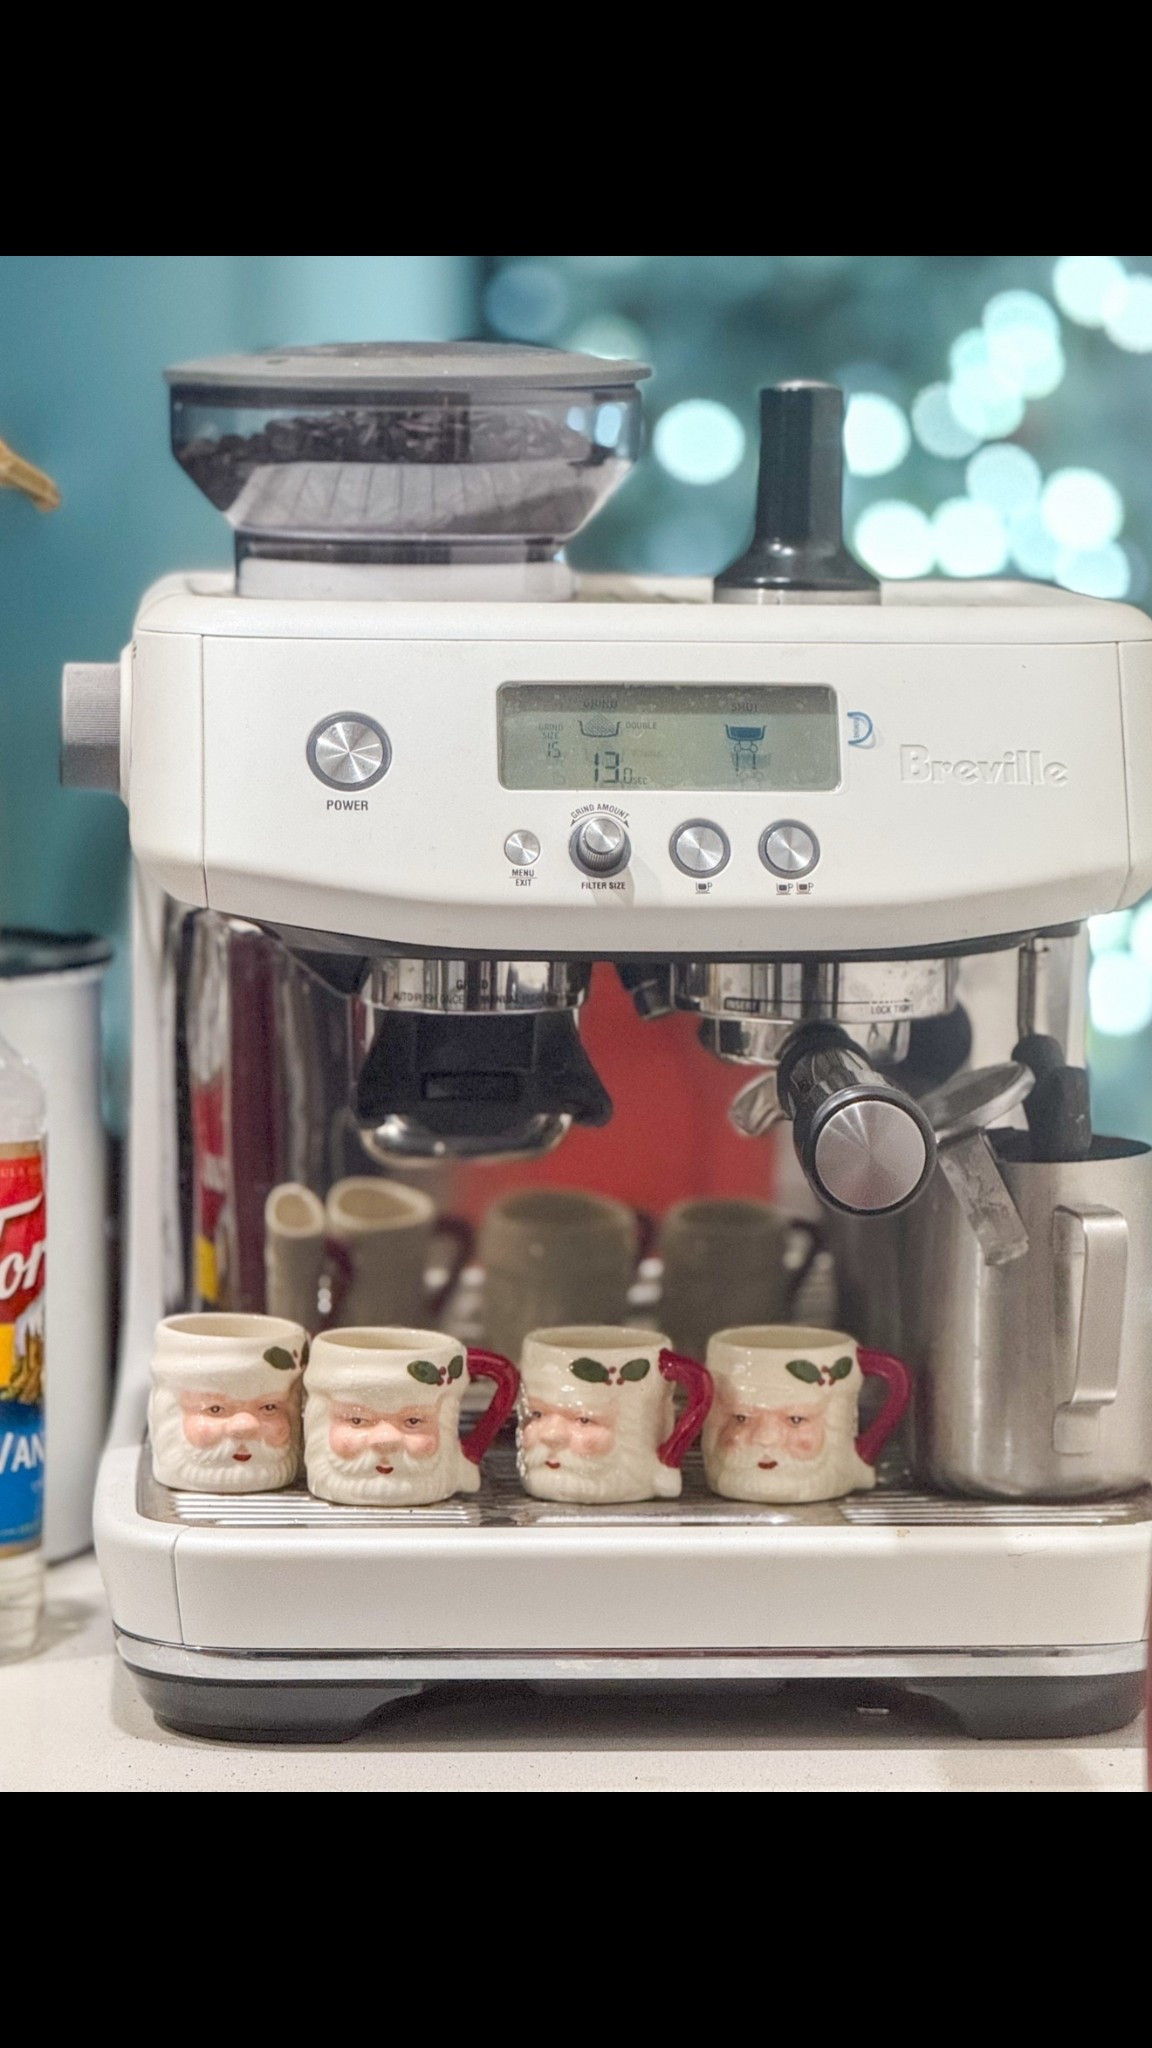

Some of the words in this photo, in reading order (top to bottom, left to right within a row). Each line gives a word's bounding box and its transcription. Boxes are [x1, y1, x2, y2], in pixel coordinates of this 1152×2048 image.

[626, 721, 657, 730] DOUBLE
[542, 732, 560, 740] SIZE
[547, 741, 561, 758] 15
[899, 743, 1068, 787] Breville
[326, 799, 369, 811] POWER
[570, 803, 595, 819] GRIND
[597, 803, 630, 819] AMOUNT
[511, 868, 535, 877] MENU
[515, 878, 532, 887] EXIT
[581, 881, 607, 890] FILTER
[609, 881, 626, 890] SIZE
[870, 1004, 891, 1015] LOCK
